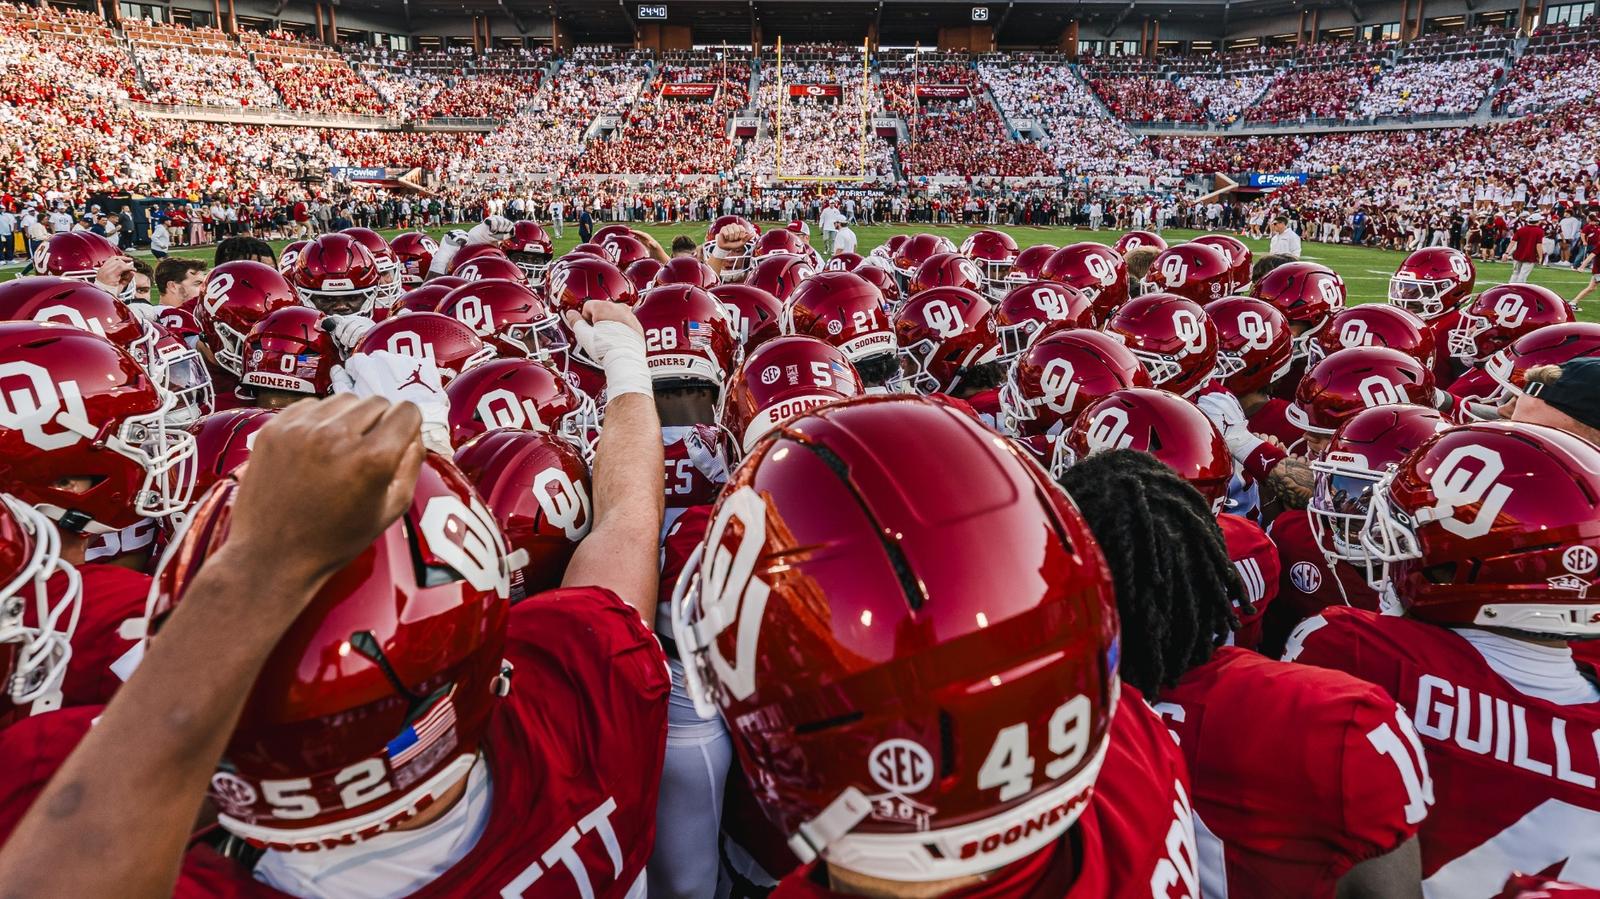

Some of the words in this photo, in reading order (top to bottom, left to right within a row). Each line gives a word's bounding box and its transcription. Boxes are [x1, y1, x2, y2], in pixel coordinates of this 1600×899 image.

[974, 9, 986, 18] 25
[347, 168, 379, 177] Fowler
[1084, 253, 1118, 286] OU
[1162, 254, 1189, 288] OU
[455, 295, 496, 337] OU
[853, 308, 880, 334] 21
[923, 299, 966, 339] OU
[1031, 287, 1070, 320] OU
[1494, 292, 1530, 329] OU
[646, 327, 677, 351] 28
[854, 335, 889, 350] SOONERS
[1172, 309, 1208, 354] OU
[1237, 310, 1275, 351] OU
[280, 354, 296, 373] 0
[647, 357, 686, 368] OONERS
[810, 361, 833, 388] 5
[249, 374, 301, 390] SOONERS
[1040, 357, 1080, 414] OU
[0, 360, 89, 451] OU
[664, 458, 695, 495] ES
[1430, 443, 1514, 540] OU
[531, 466, 593, 542] OU
[419, 495, 511, 600] OU
[1567, 547, 1594, 572] SEC
[702, 484, 771, 702] OU
[1290, 563, 1322, 592] SEC
[977, 693, 1092, 802] 49
[1414, 673, 1600, 790] GUILL
[874, 745, 926, 788] SEC
[260, 757, 393, 820] 52
